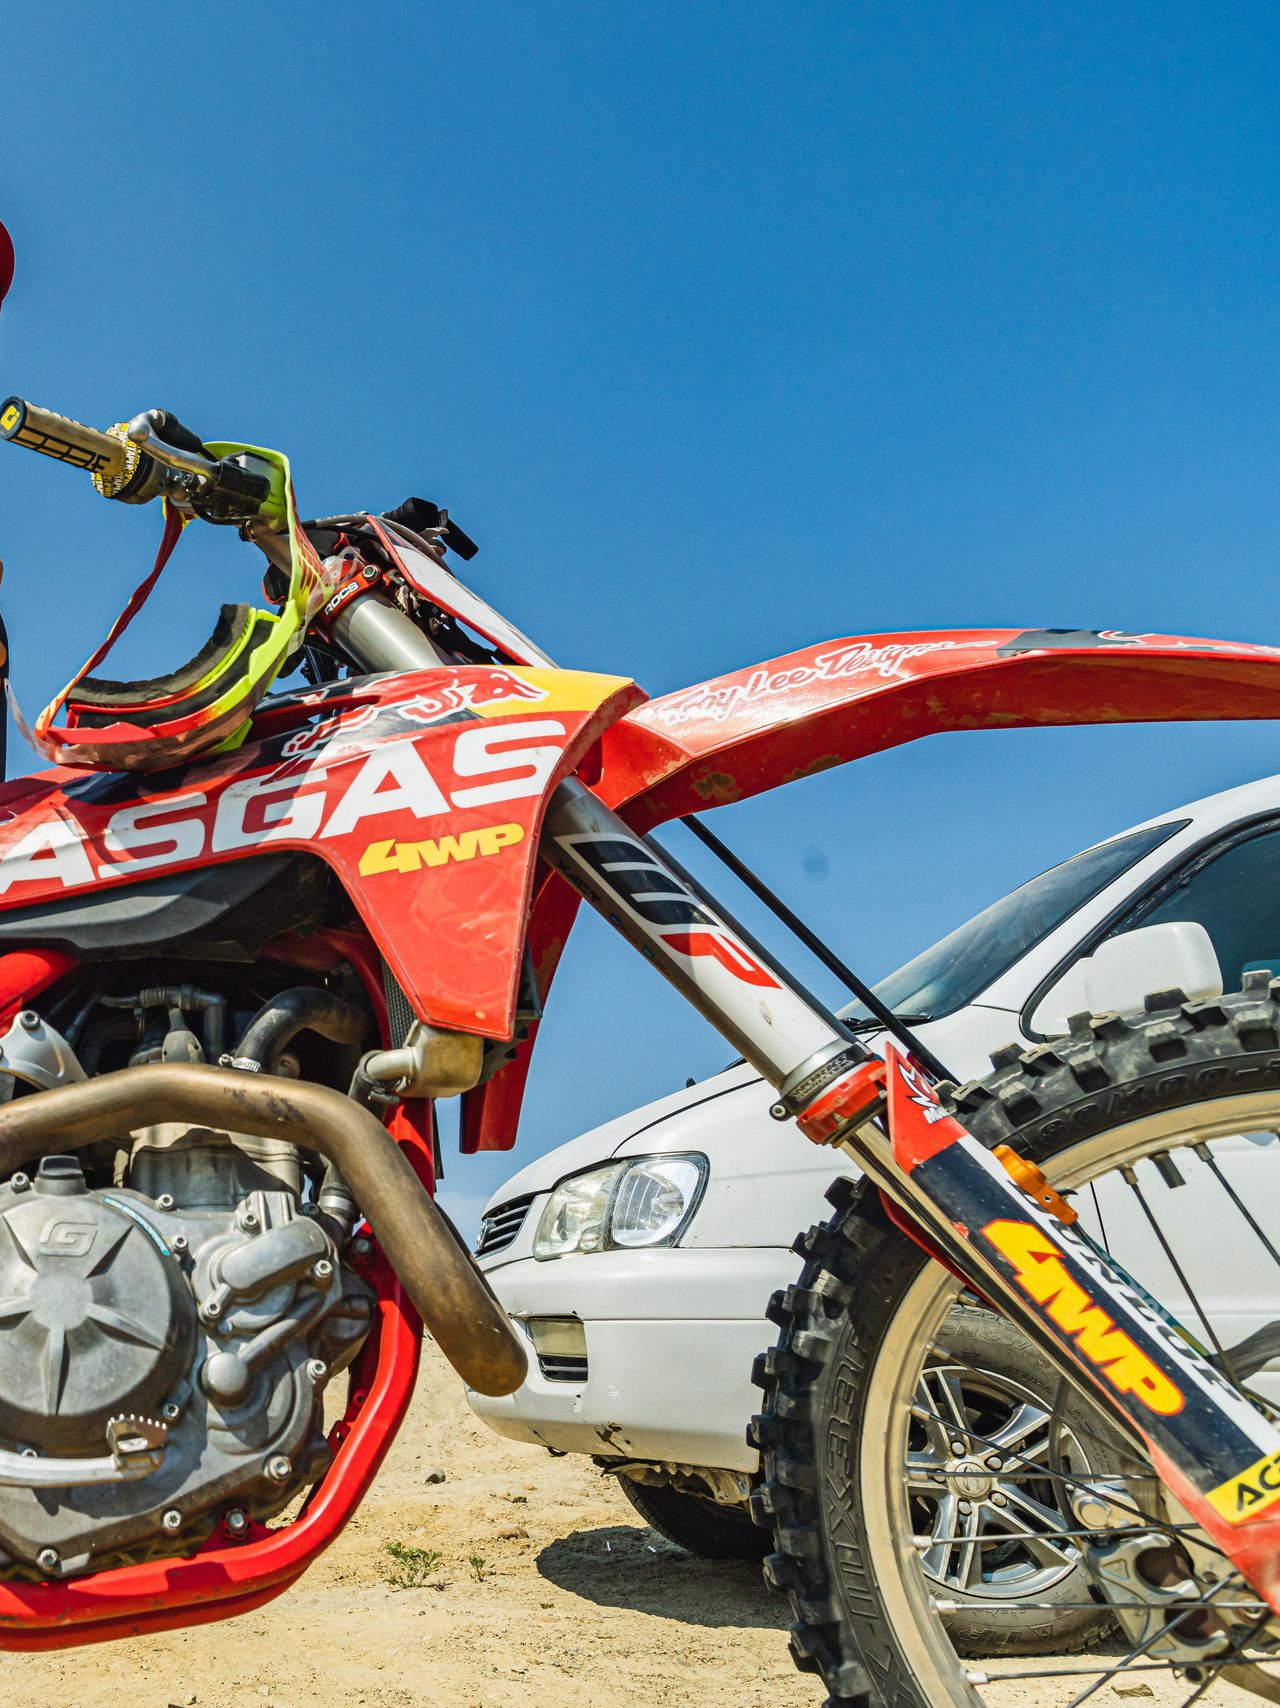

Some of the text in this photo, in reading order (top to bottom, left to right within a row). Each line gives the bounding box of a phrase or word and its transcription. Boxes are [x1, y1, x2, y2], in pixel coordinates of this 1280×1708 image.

[736, 671, 819, 701] Lee
[358, 823, 525, 877] 4WP
[979, 1218, 1186, 1416] 4WP
